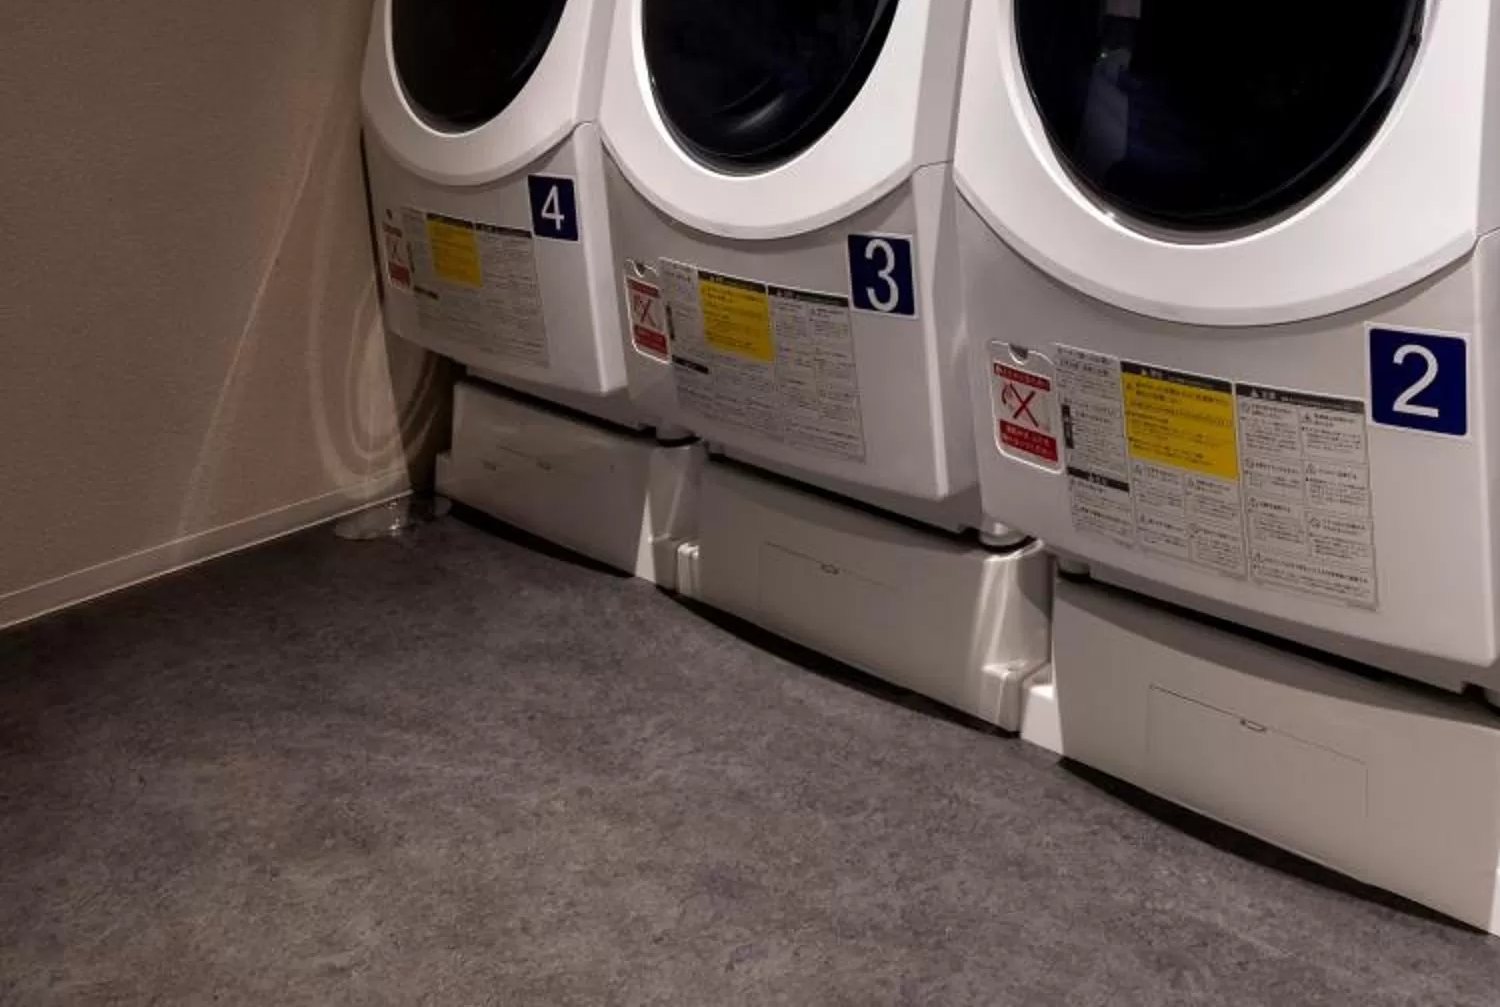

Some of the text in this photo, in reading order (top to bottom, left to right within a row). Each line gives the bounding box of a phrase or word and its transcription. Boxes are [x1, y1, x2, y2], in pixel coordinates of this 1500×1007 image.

[541, 184, 565, 231] 4
[864, 239, 900, 312] 3
[1392, 343, 1440, 419] 2
